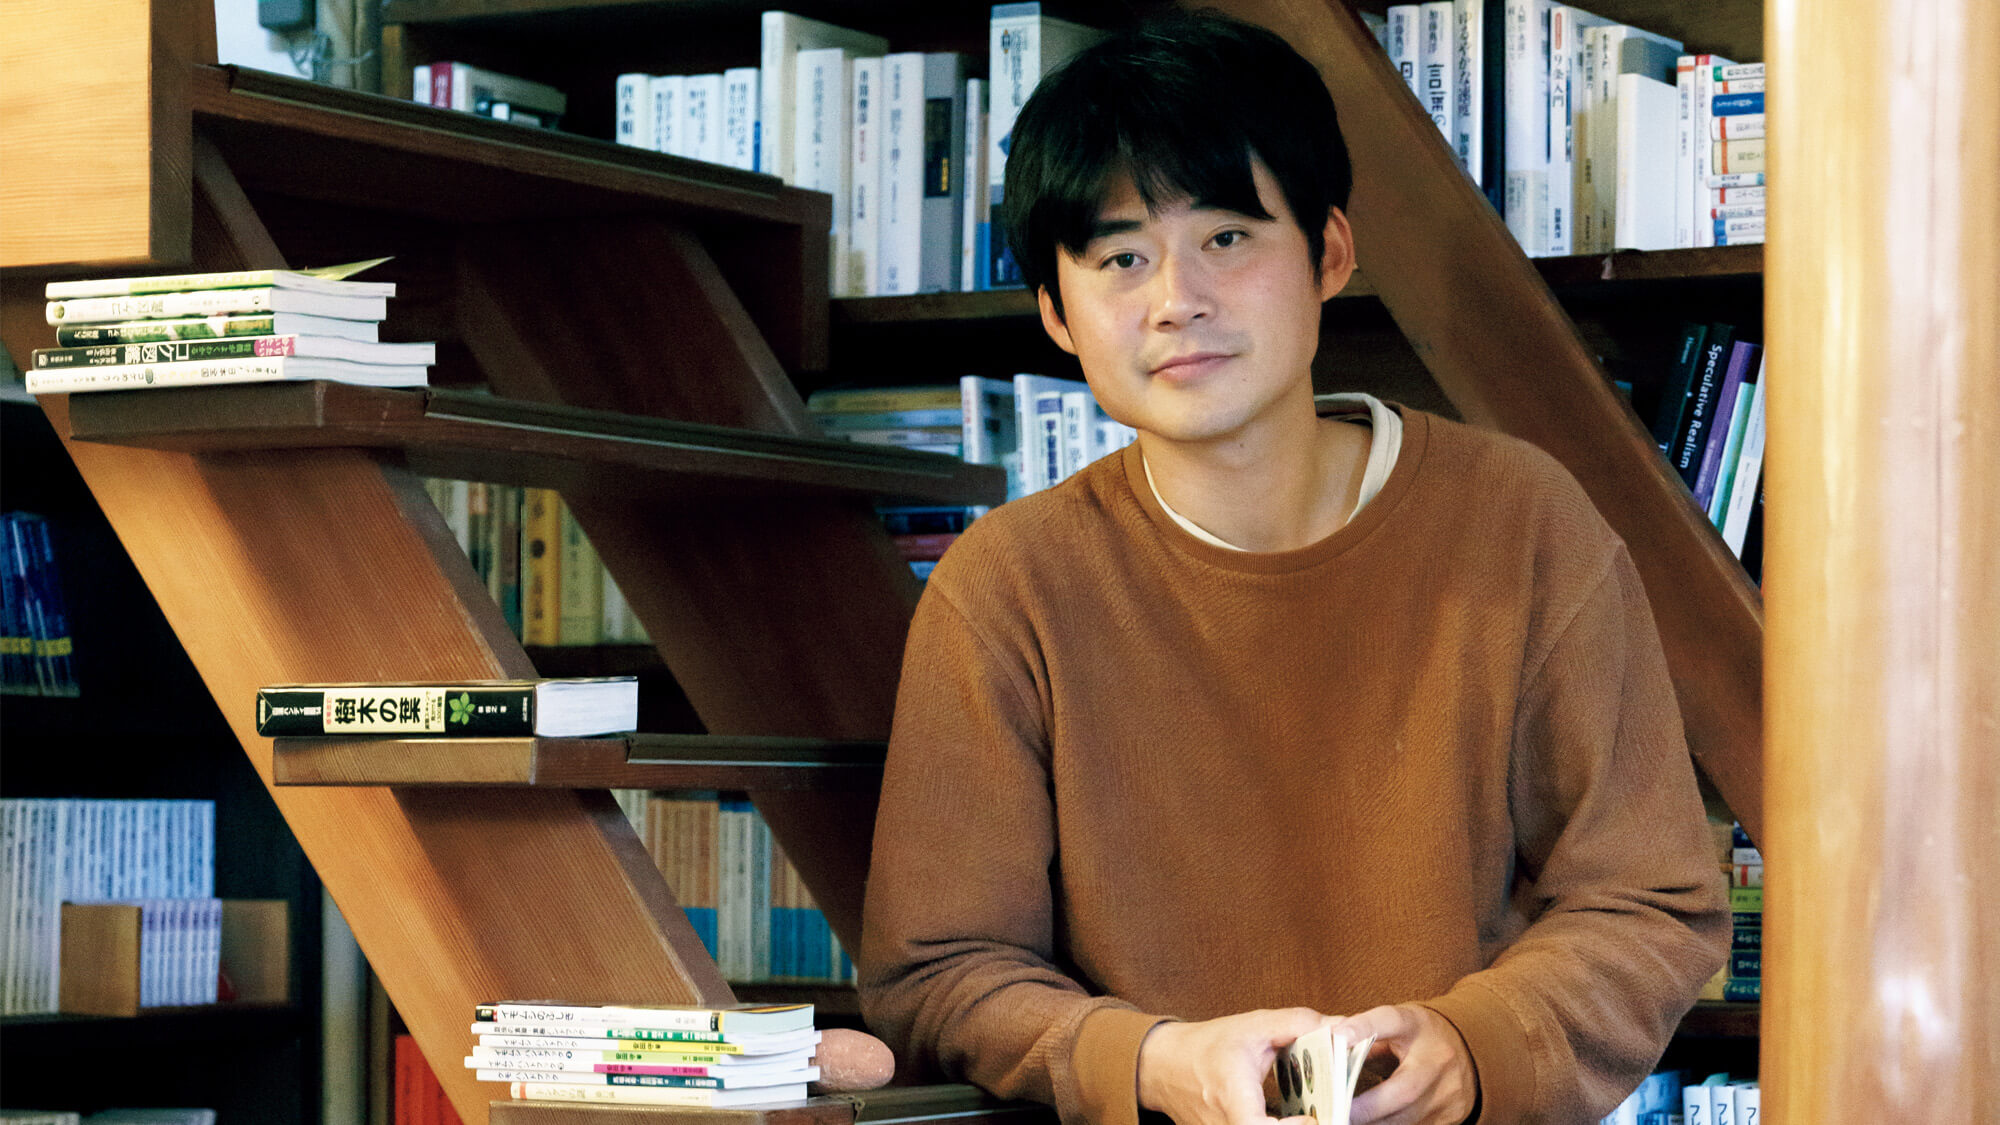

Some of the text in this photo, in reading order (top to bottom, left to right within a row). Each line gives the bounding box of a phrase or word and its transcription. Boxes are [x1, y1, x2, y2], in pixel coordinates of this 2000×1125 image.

[125, 343, 190, 366] コケ図鑑
[1693, 344, 1722, 417] Speculative
[1680, 420, 1702, 469] Realism
[334, 697, 422, 725] 樹木の葉
[501, 1009, 574, 1022] イモムシのふしぎ
[504, 1039, 533, 1048] イモムシ
[494, 1049, 523, 1058] イモムシ
[524, 1050, 566, 1059] ハンドブック
[488, 1059, 517, 1069] イモムシ
[497, 1073, 560, 1082] クモ ハンドブック
